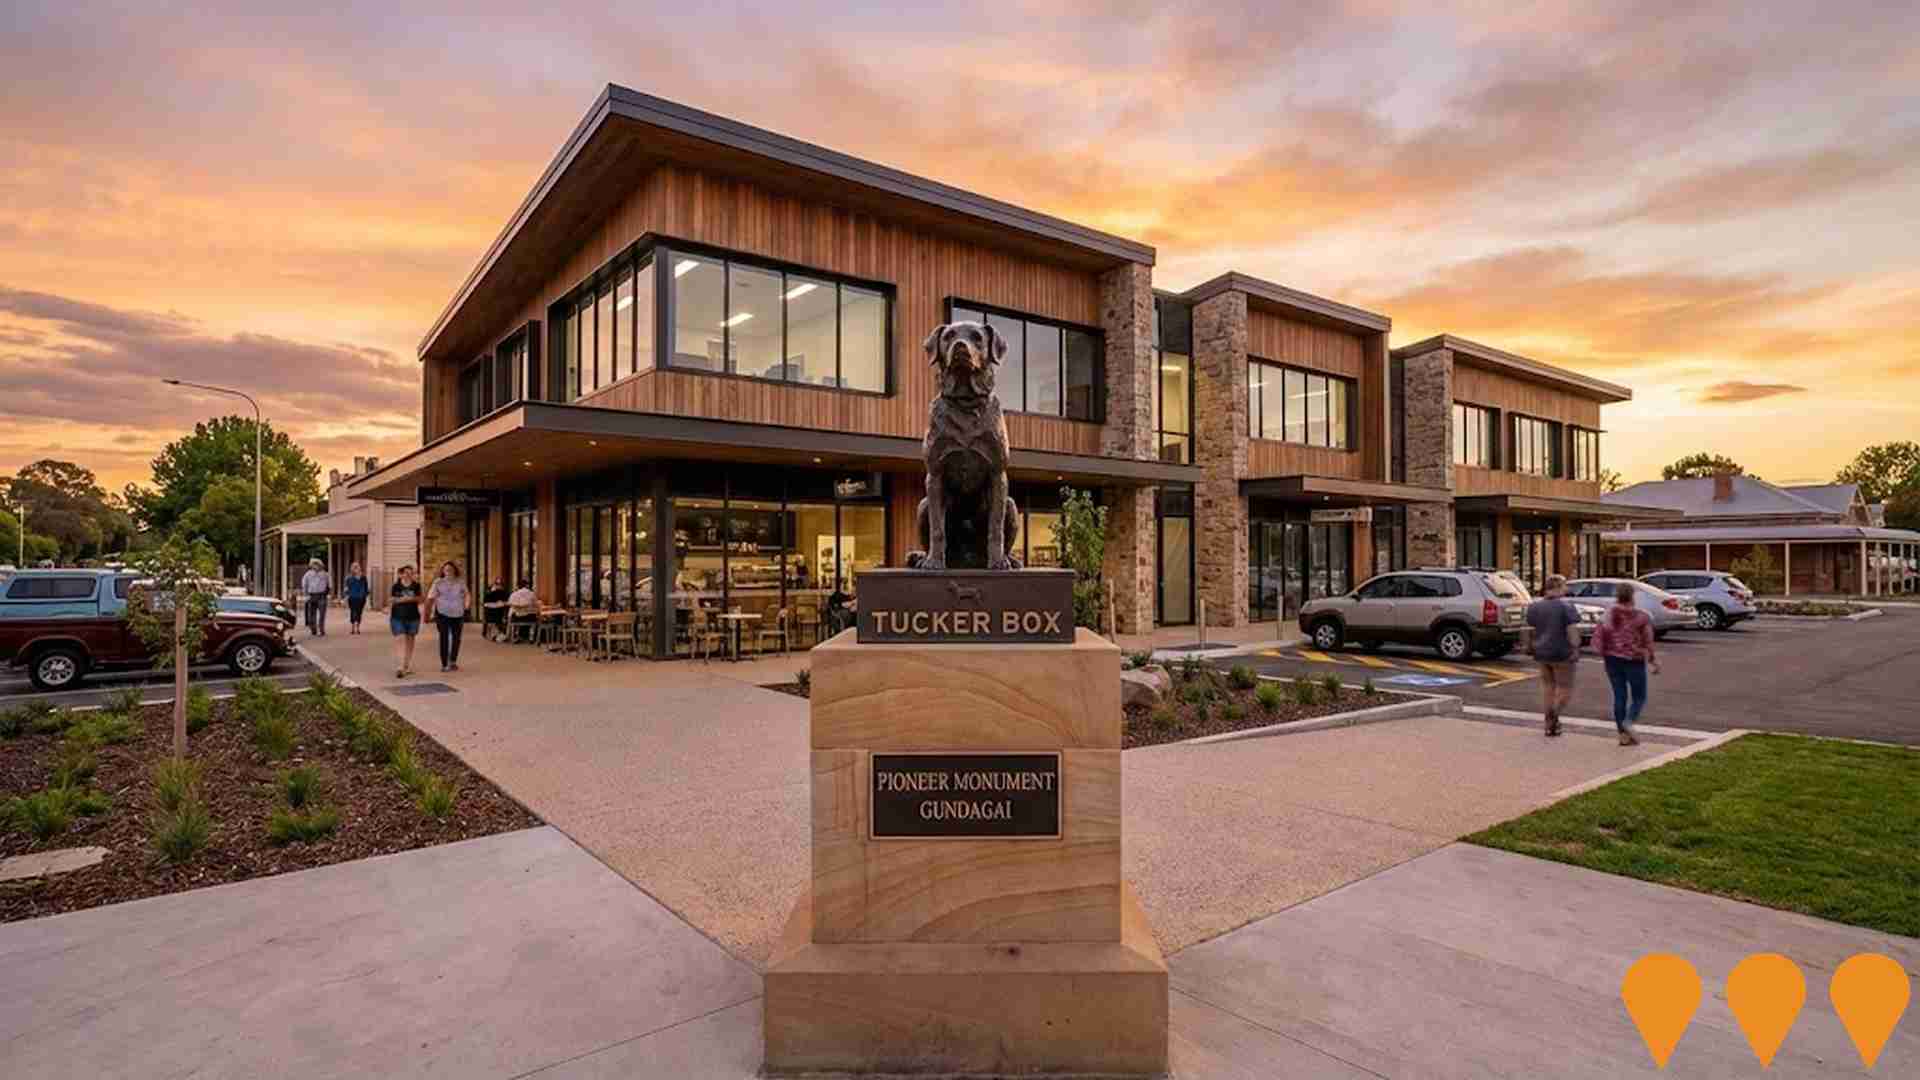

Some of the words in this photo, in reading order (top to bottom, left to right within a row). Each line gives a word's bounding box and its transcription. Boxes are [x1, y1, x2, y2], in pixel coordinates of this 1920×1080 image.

[871, 611, 991, 634] TUCKER
[1002, 611, 1061, 634] BOX
[877, 771, 949, 791] PIONEER
[954, 771, 1056, 791] MONUMENT
[919, 800, 1013, 819] GUNDAGAI
